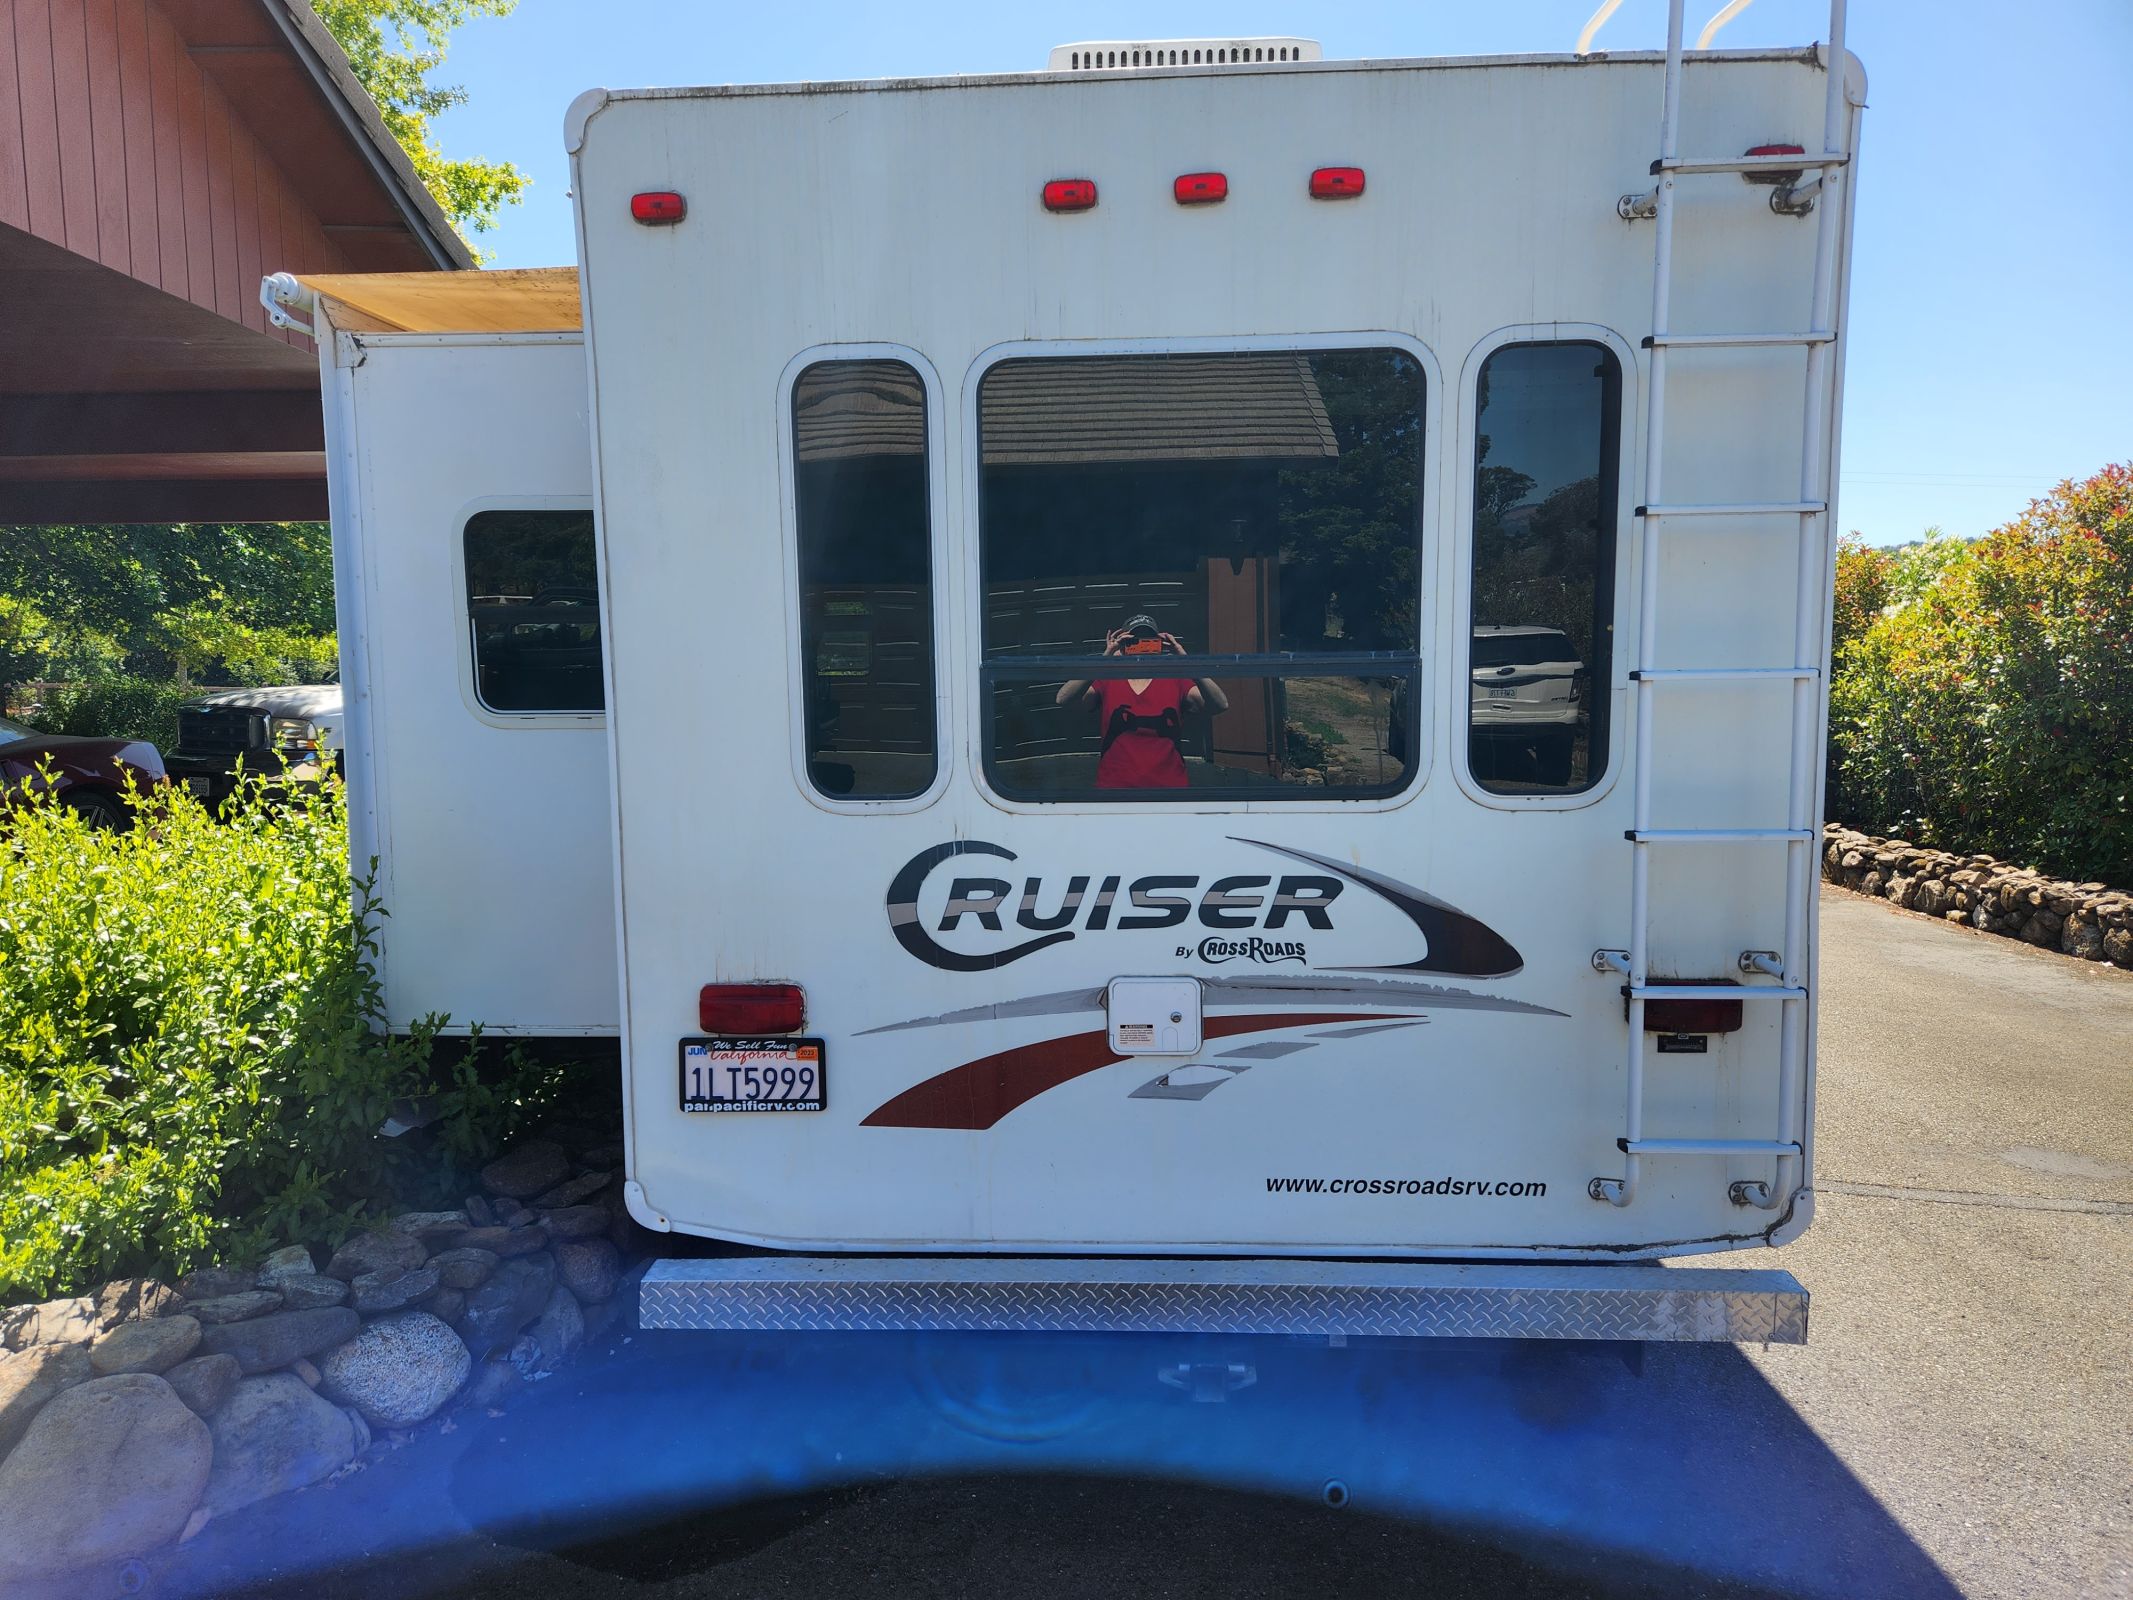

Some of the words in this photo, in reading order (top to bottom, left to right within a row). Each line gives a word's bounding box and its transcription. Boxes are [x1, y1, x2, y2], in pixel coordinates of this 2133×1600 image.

[886, 840, 1344, 972] CRUISER
[1175, 946, 1194, 959] By
[688, 1047, 707, 1056] JUN
[713, 1041, 731, 1050] We
[735, 1040, 760, 1050] Sell
[763, 1040, 788, 1050] Fun
[691, 1068, 814, 1099] 1LT5999
[1266, 1176, 1547, 1197] www.crossroadsrv.com
